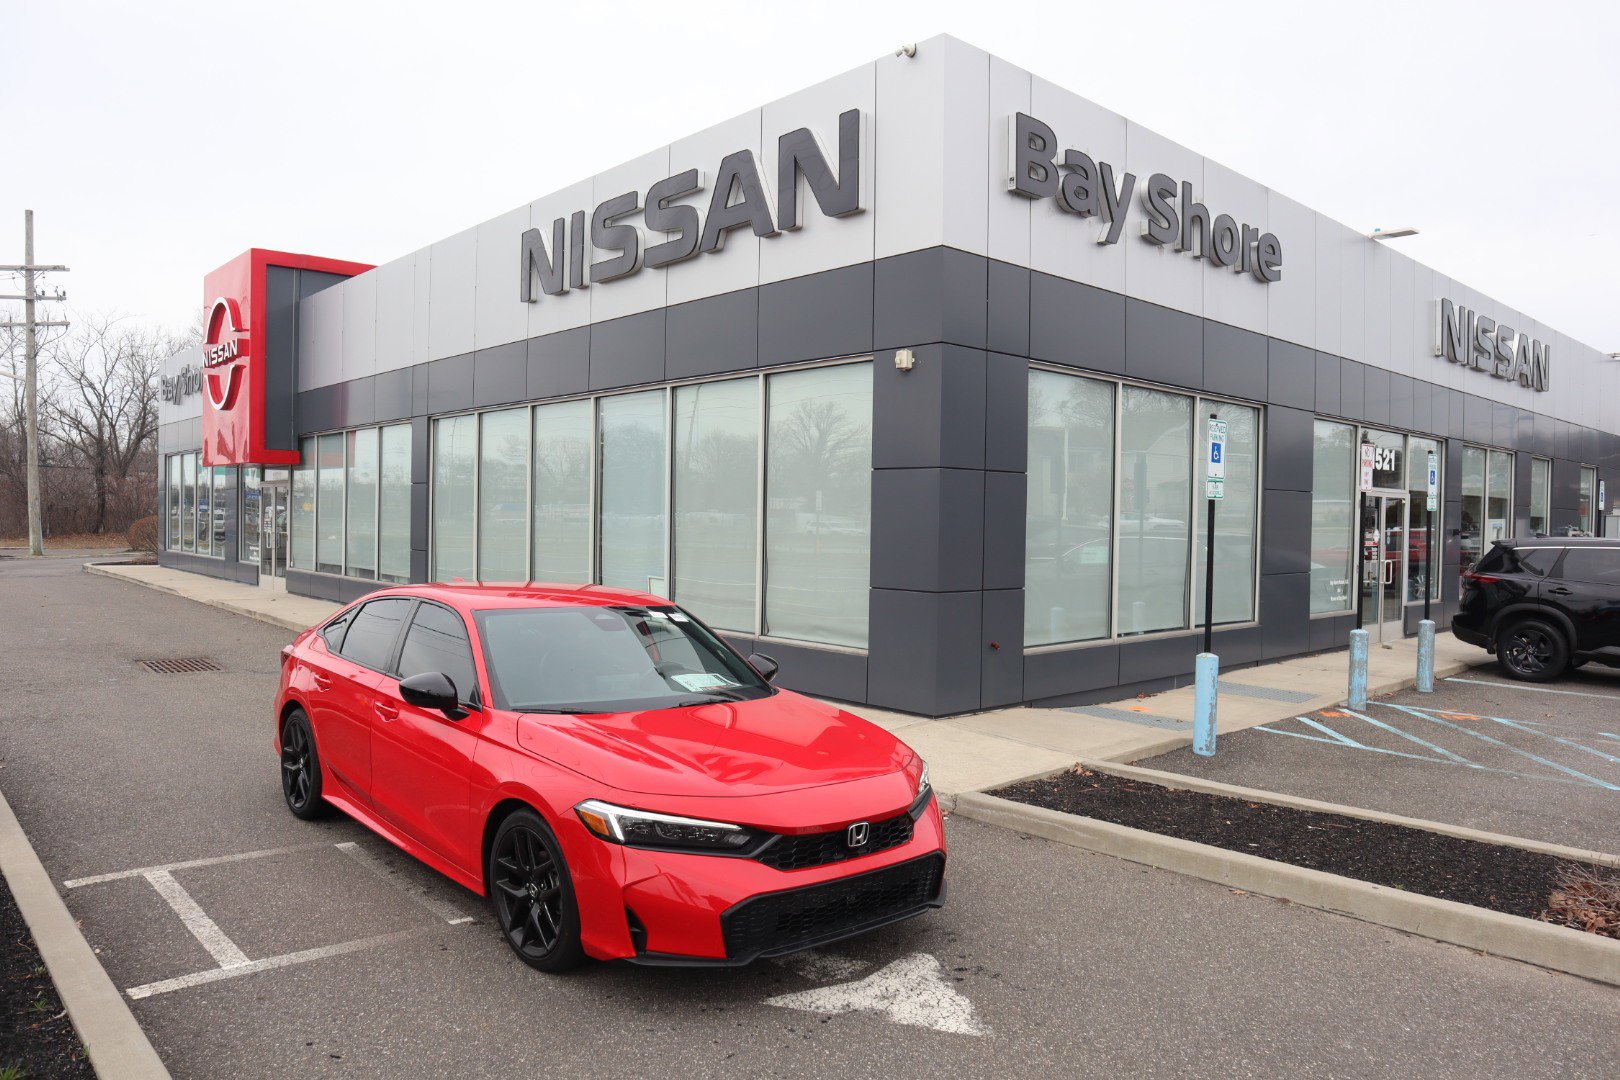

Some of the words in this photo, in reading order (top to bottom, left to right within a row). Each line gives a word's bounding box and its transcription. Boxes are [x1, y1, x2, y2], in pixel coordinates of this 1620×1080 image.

[520, 108, 861, 303] NISSAN
[1012, 111, 1137, 245] Bay
[1145, 173, 1283, 283] Shore
[161, 375, 181, 405] Bay
[203, 339, 238, 369] NISSAN
[1440, 297, 1551, 393] NISSAN
